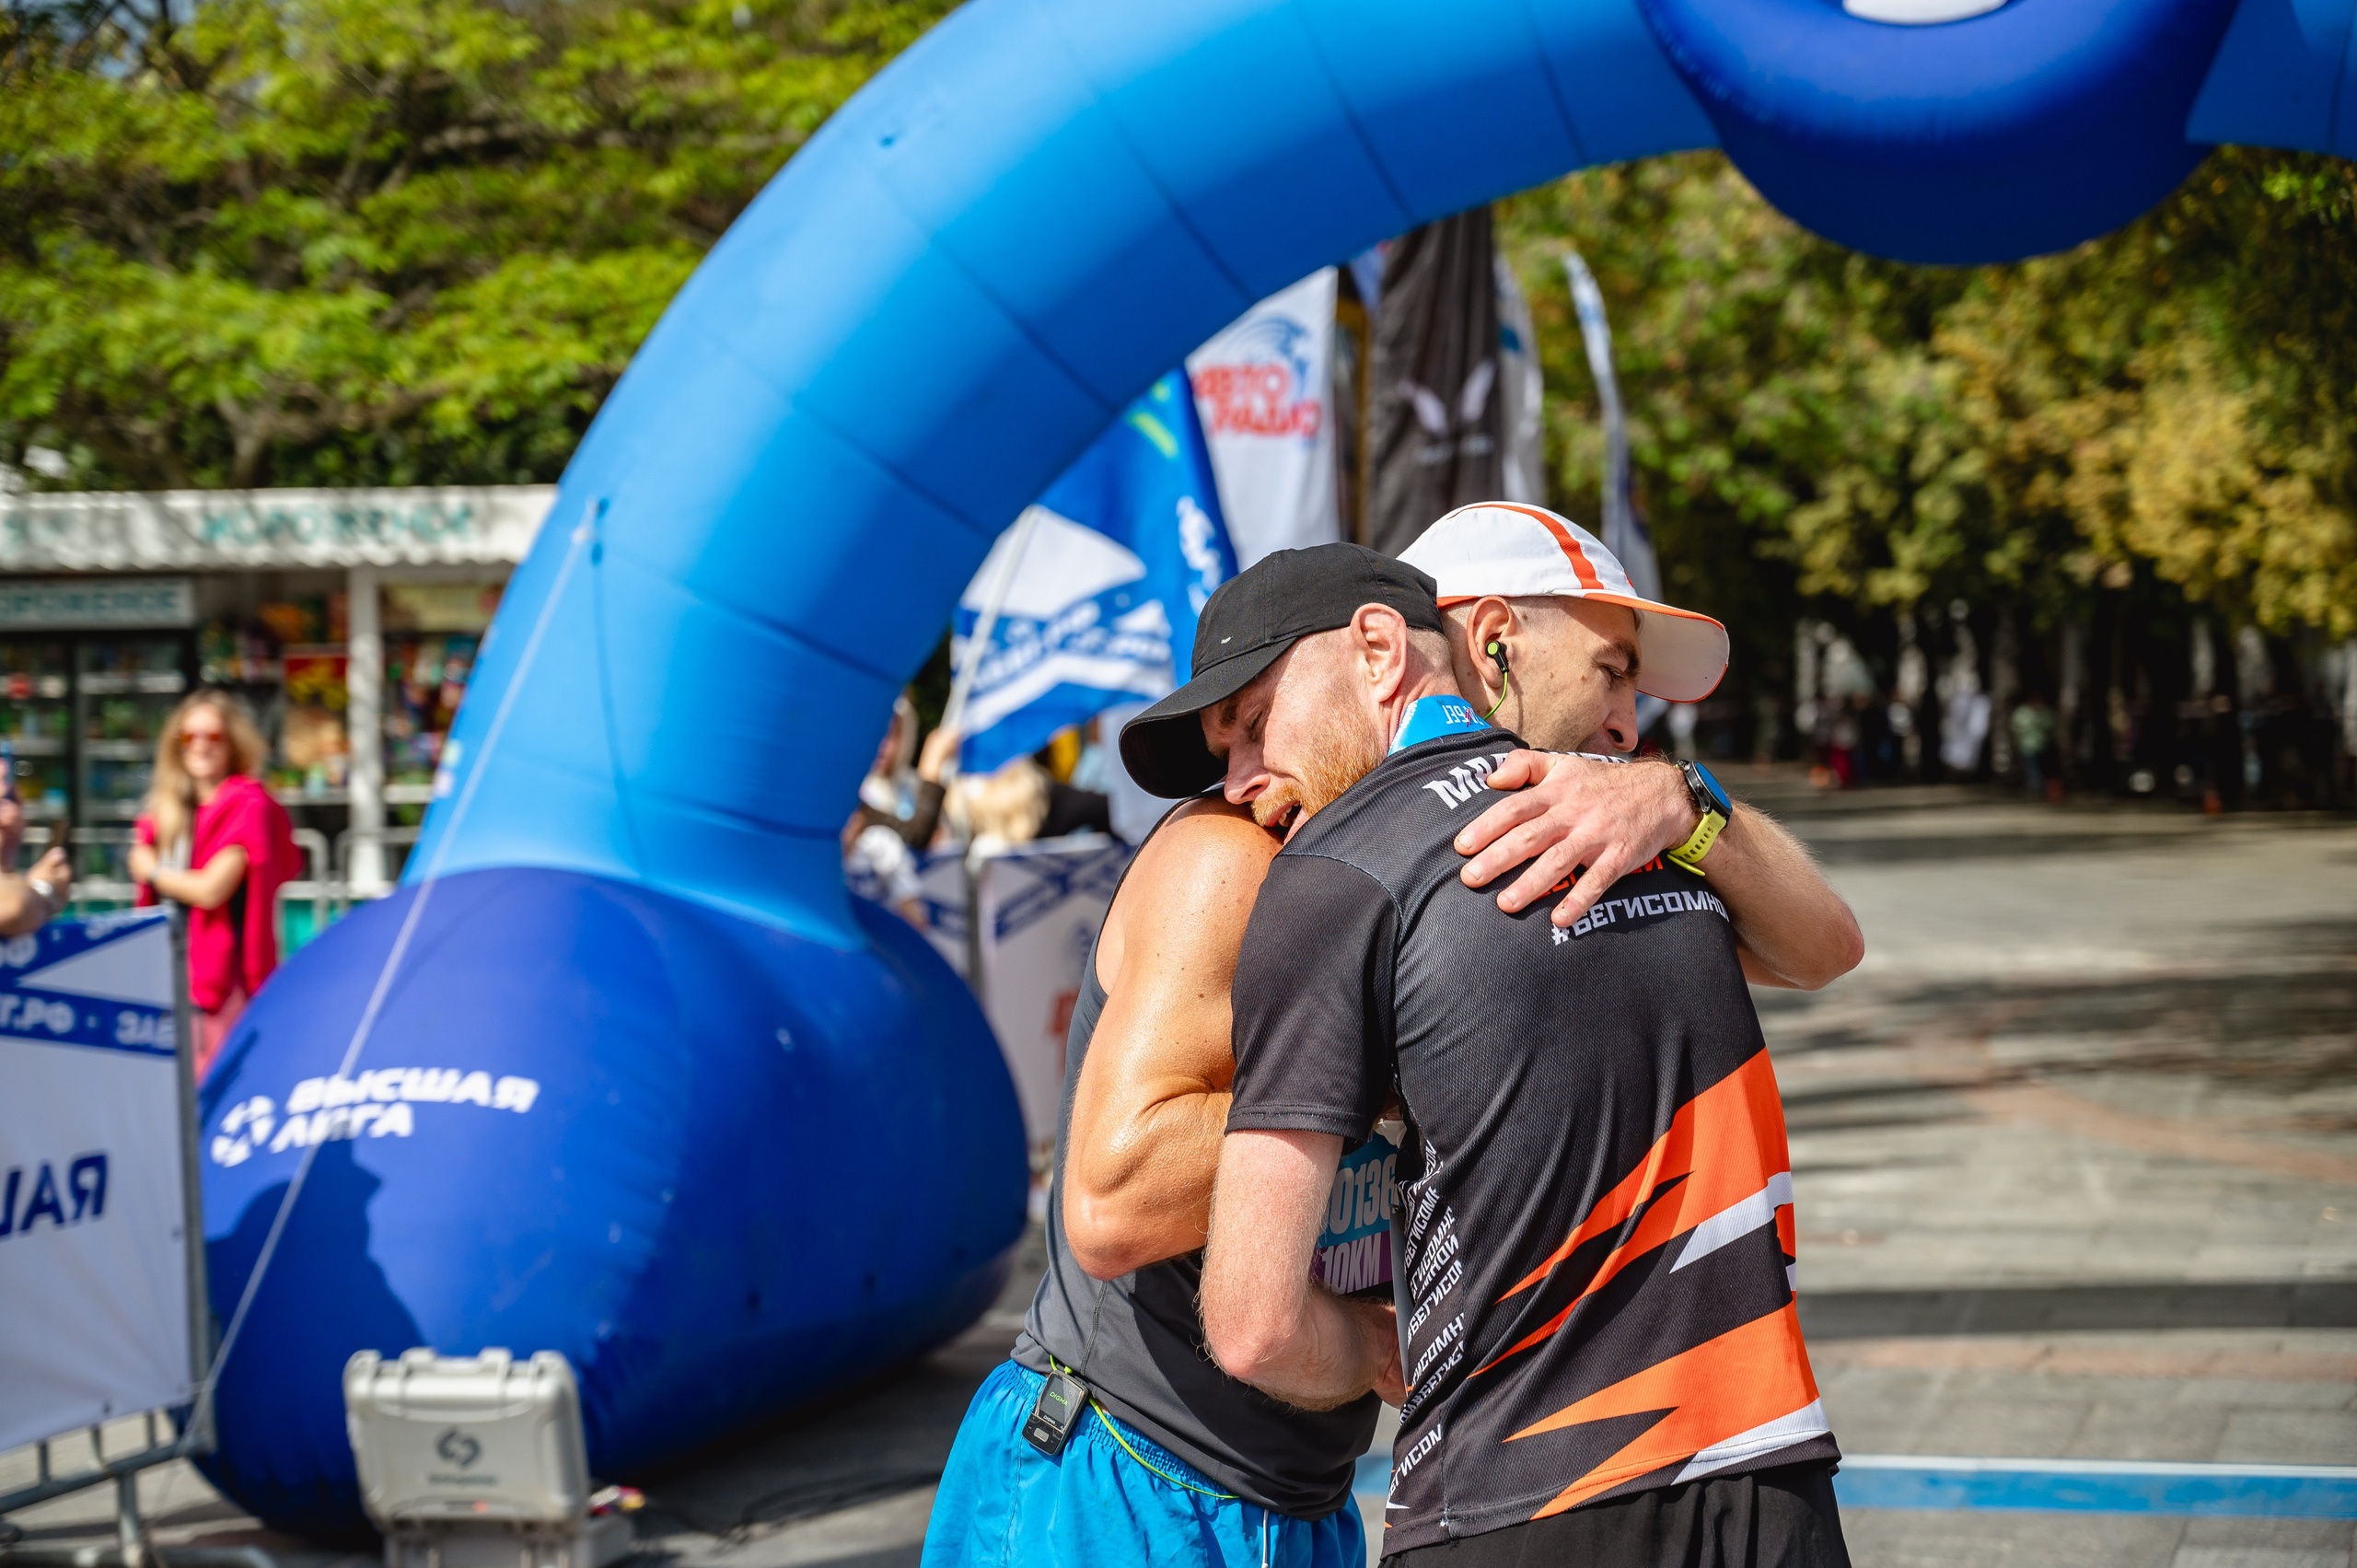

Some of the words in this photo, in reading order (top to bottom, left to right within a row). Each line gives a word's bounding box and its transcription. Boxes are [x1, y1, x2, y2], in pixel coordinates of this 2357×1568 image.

[286, 1067, 540, 1113] ВЫСШАЯ
[269, 1102, 412, 1153] ЛИГА
[1050, 1391, 1069, 1407] DIGMA
[1043, 1414, 1056, 1425] DIGMA
